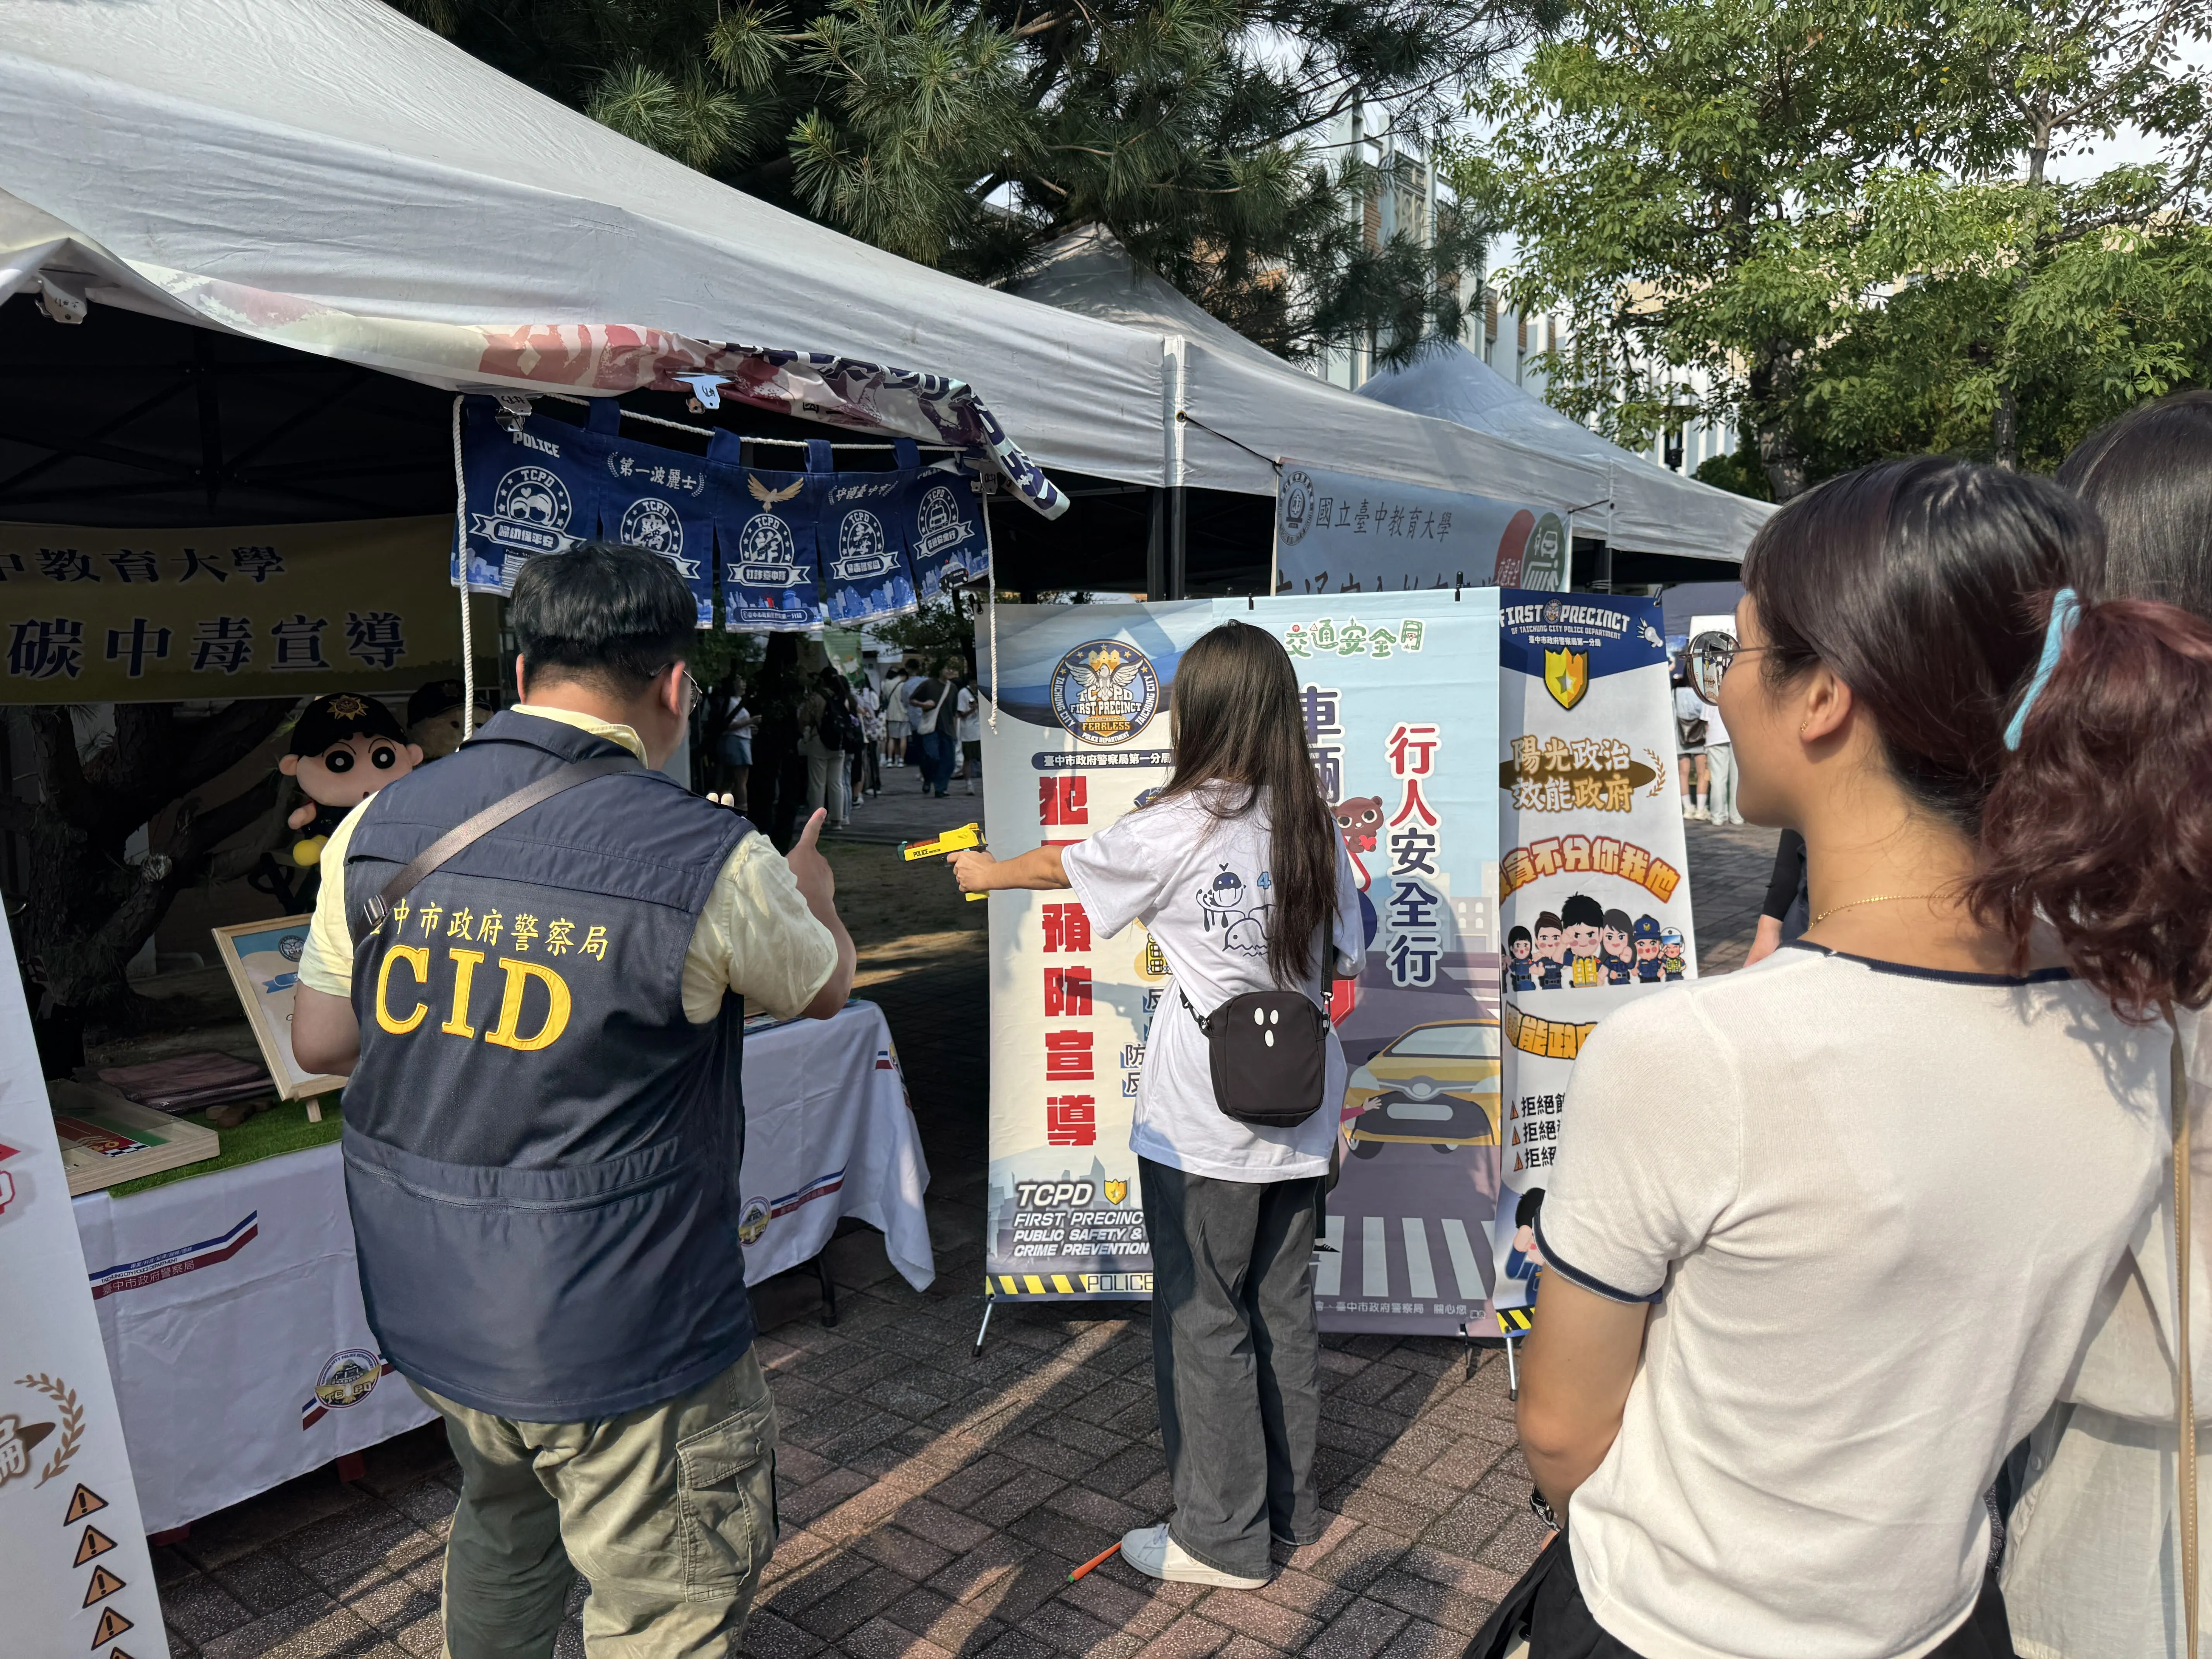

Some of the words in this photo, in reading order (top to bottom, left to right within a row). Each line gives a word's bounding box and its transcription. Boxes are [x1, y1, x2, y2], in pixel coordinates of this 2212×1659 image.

[513, 431, 560, 458] POLICE
[520, 469, 555, 488] TCPD
[620, 457, 697, 490] 第一波麗士
[927, 489, 945, 503] TCPD
[642, 501, 670, 517] TCPD
[848, 512, 870, 524] TCPD
[1317, 497, 1452, 542] 國立臺中教育大學
[754, 517, 781, 530] TCPD
[498, 524, 555, 549] 婦幼保平安
[1499, 605, 1544, 628] FIRST
[1560, 605, 1631, 632] PRECINCT
[1286, 618, 1423, 658] 交通安全月
[1511, 627, 1519, 635] OF
[1519, 625, 1547, 633] TAICHUNG
[1584, 627, 1621, 640] DEPARTMENT
[7, 613, 405, 678] 碳中毒宣導
[1144, 675, 1156, 692] CITY
[1054, 676, 1065, 711] TAICHUNG
[1061, 710, 1076, 727] CITY
[1070, 702, 1097, 715] FIRST
[1098, 700, 1142, 716] PRECINCT
[1134, 692, 1156, 726] TAICHUNG
[1082, 721, 1131, 731] FEARLESS
[1082, 732, 1098, 742] POLICE
[1099, 730, 1130, 743] DEPARTMENT
[1043, 752, 1171, 767] 臺中市政府警察局第一分局
[1511, 737, 1631, 773] 陽光政治
[1512, 775, 1634, 812] 效能政府
[913, 848, 929, 857] POLICE
[1389, 726, 1438, 982] 行人安全行
[371, 898, 608, 961] 中市政府警察局
[1039, 775, 1097, 1146] 犯預防宣導
[376, 945, 572, 1051] CID
[1523, 1120, 1561, 1143] 拒絕
[1018, 1183, 1093, 1207] TCPD
[1013, 1212, 1066, 1227] FIRST
[1070, 1211, 1144, 1226] PRECINC
[1013, 1229, 1065, 1242] PUBLIC
[1069, 1228, 1127, 1241] SAFETY
[1130, 1227, 1142, 1240] &
[1013, 1243, 1058, 1257] CRIME
[1061, 1242, 1151, 1256] PREVENTION
[134, 1266, 149, 1275] POLICE
[149, 1257, 178, 1271] DEPARTMENT
[102, 1260, 194, 1296] 臺中市政府警察局
[1087, 1274, 1154, 1291] POLICE
[1434, 1303, 1467, 1315] 關心您
